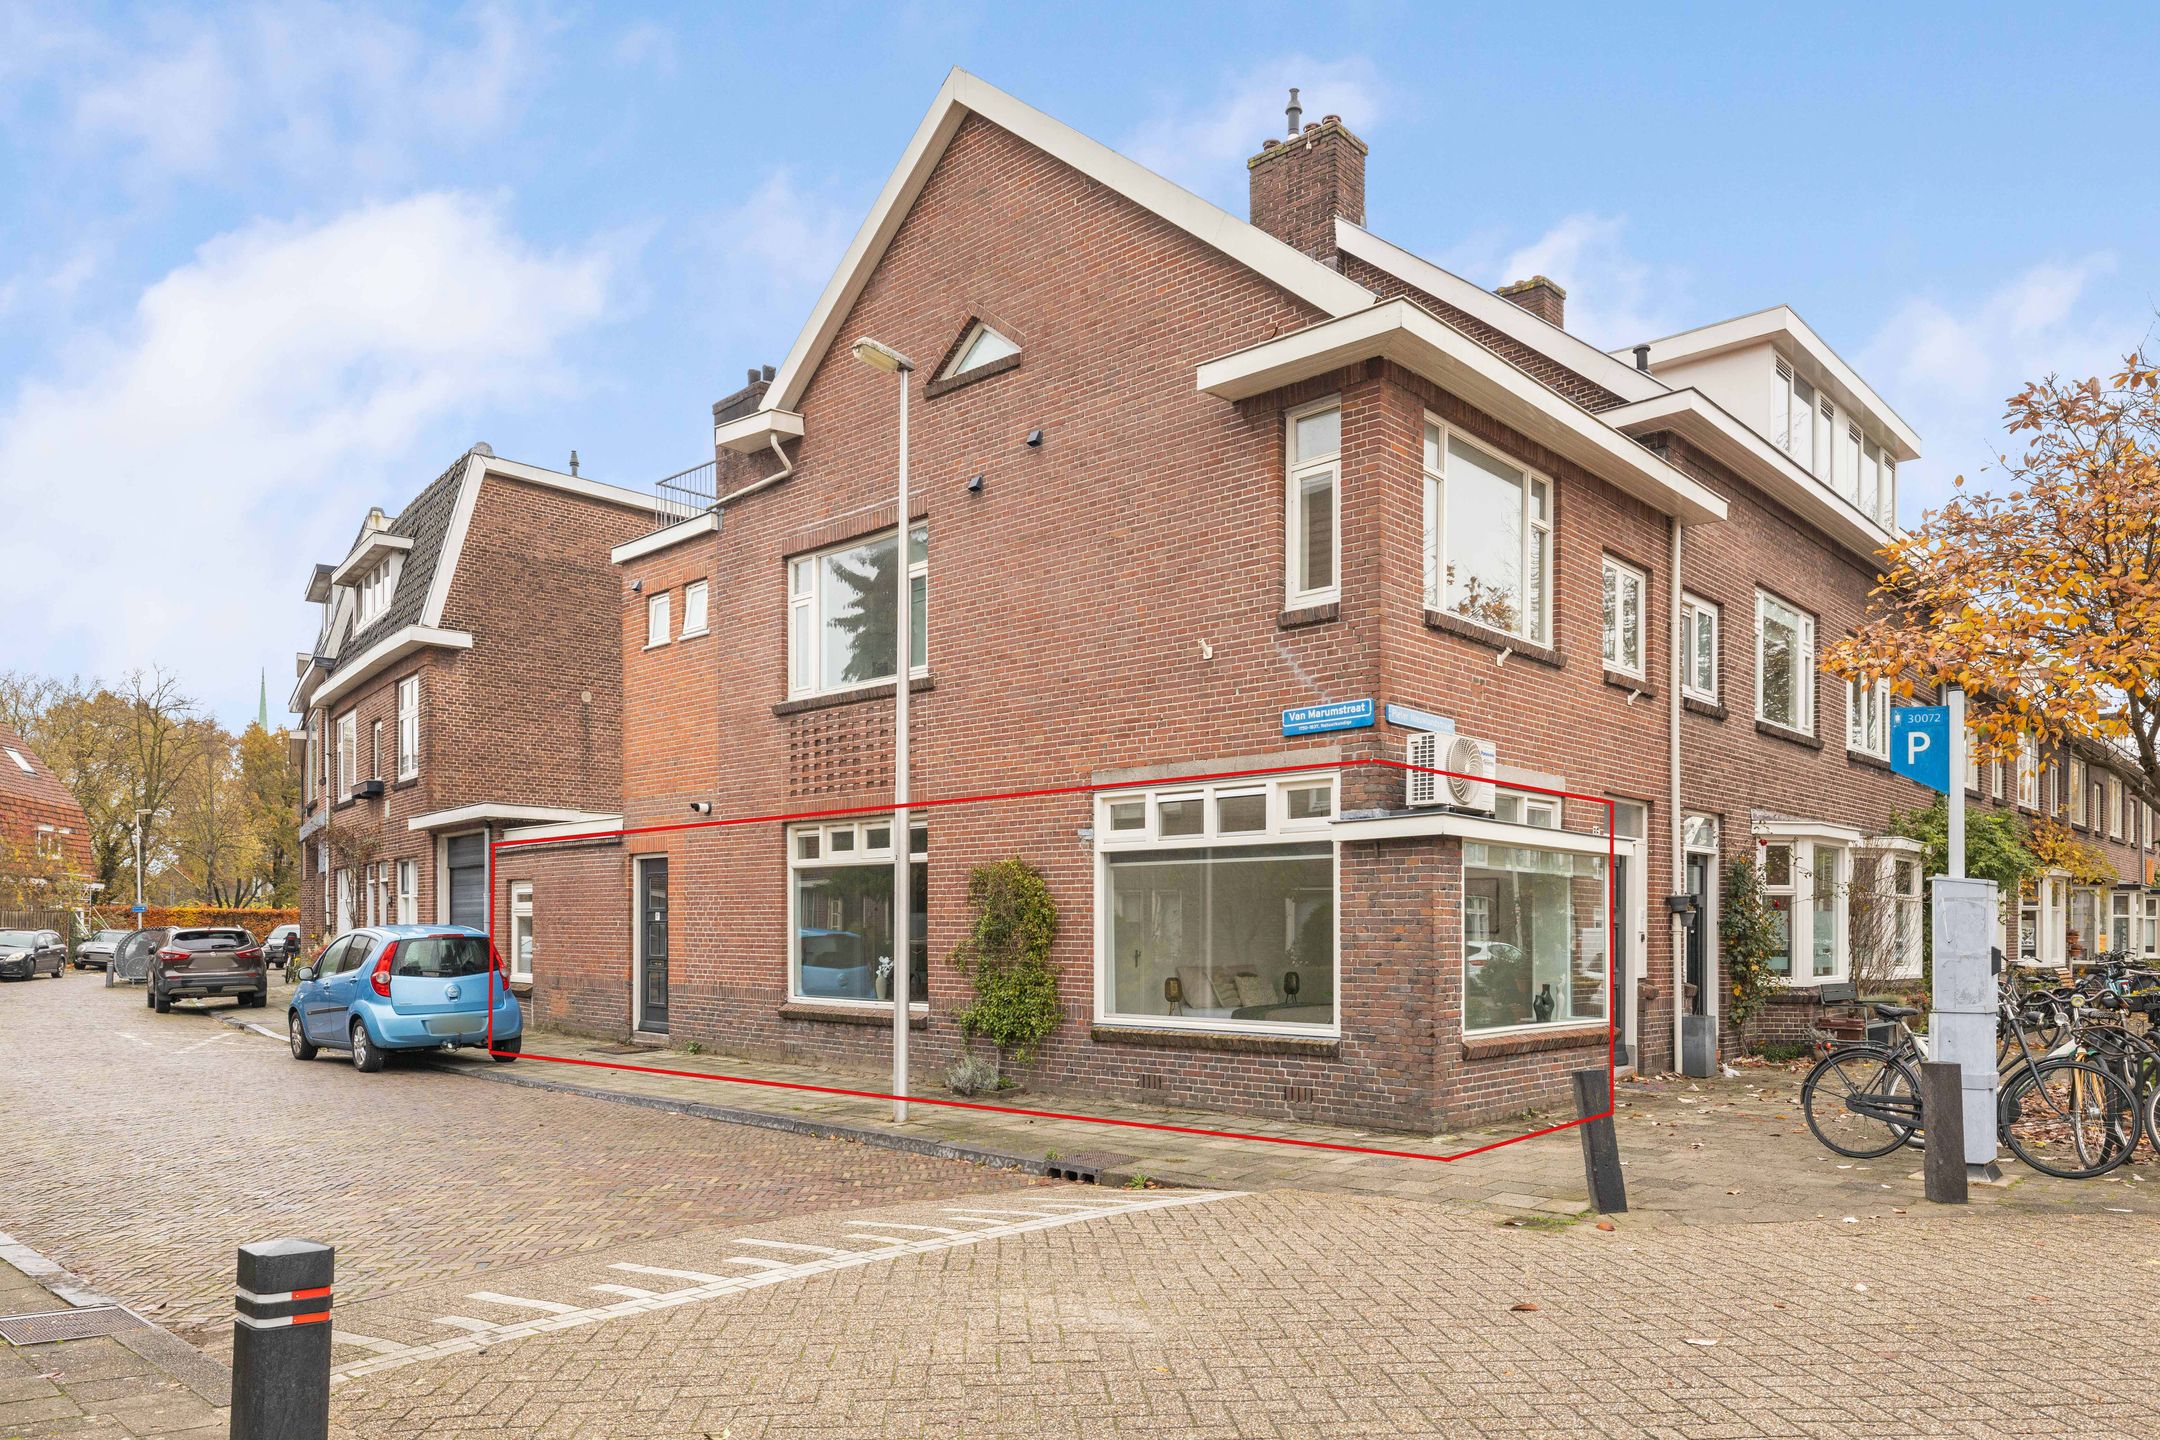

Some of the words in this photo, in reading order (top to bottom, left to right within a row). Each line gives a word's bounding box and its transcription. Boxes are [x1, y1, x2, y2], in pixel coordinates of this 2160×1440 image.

[1289, 711, 1306, 721] Van
[1308, 702, 1365, 719] Marumstraat
[1908, 713, 1941, 723] 30072
[1908, 731, 1931, 765] P
